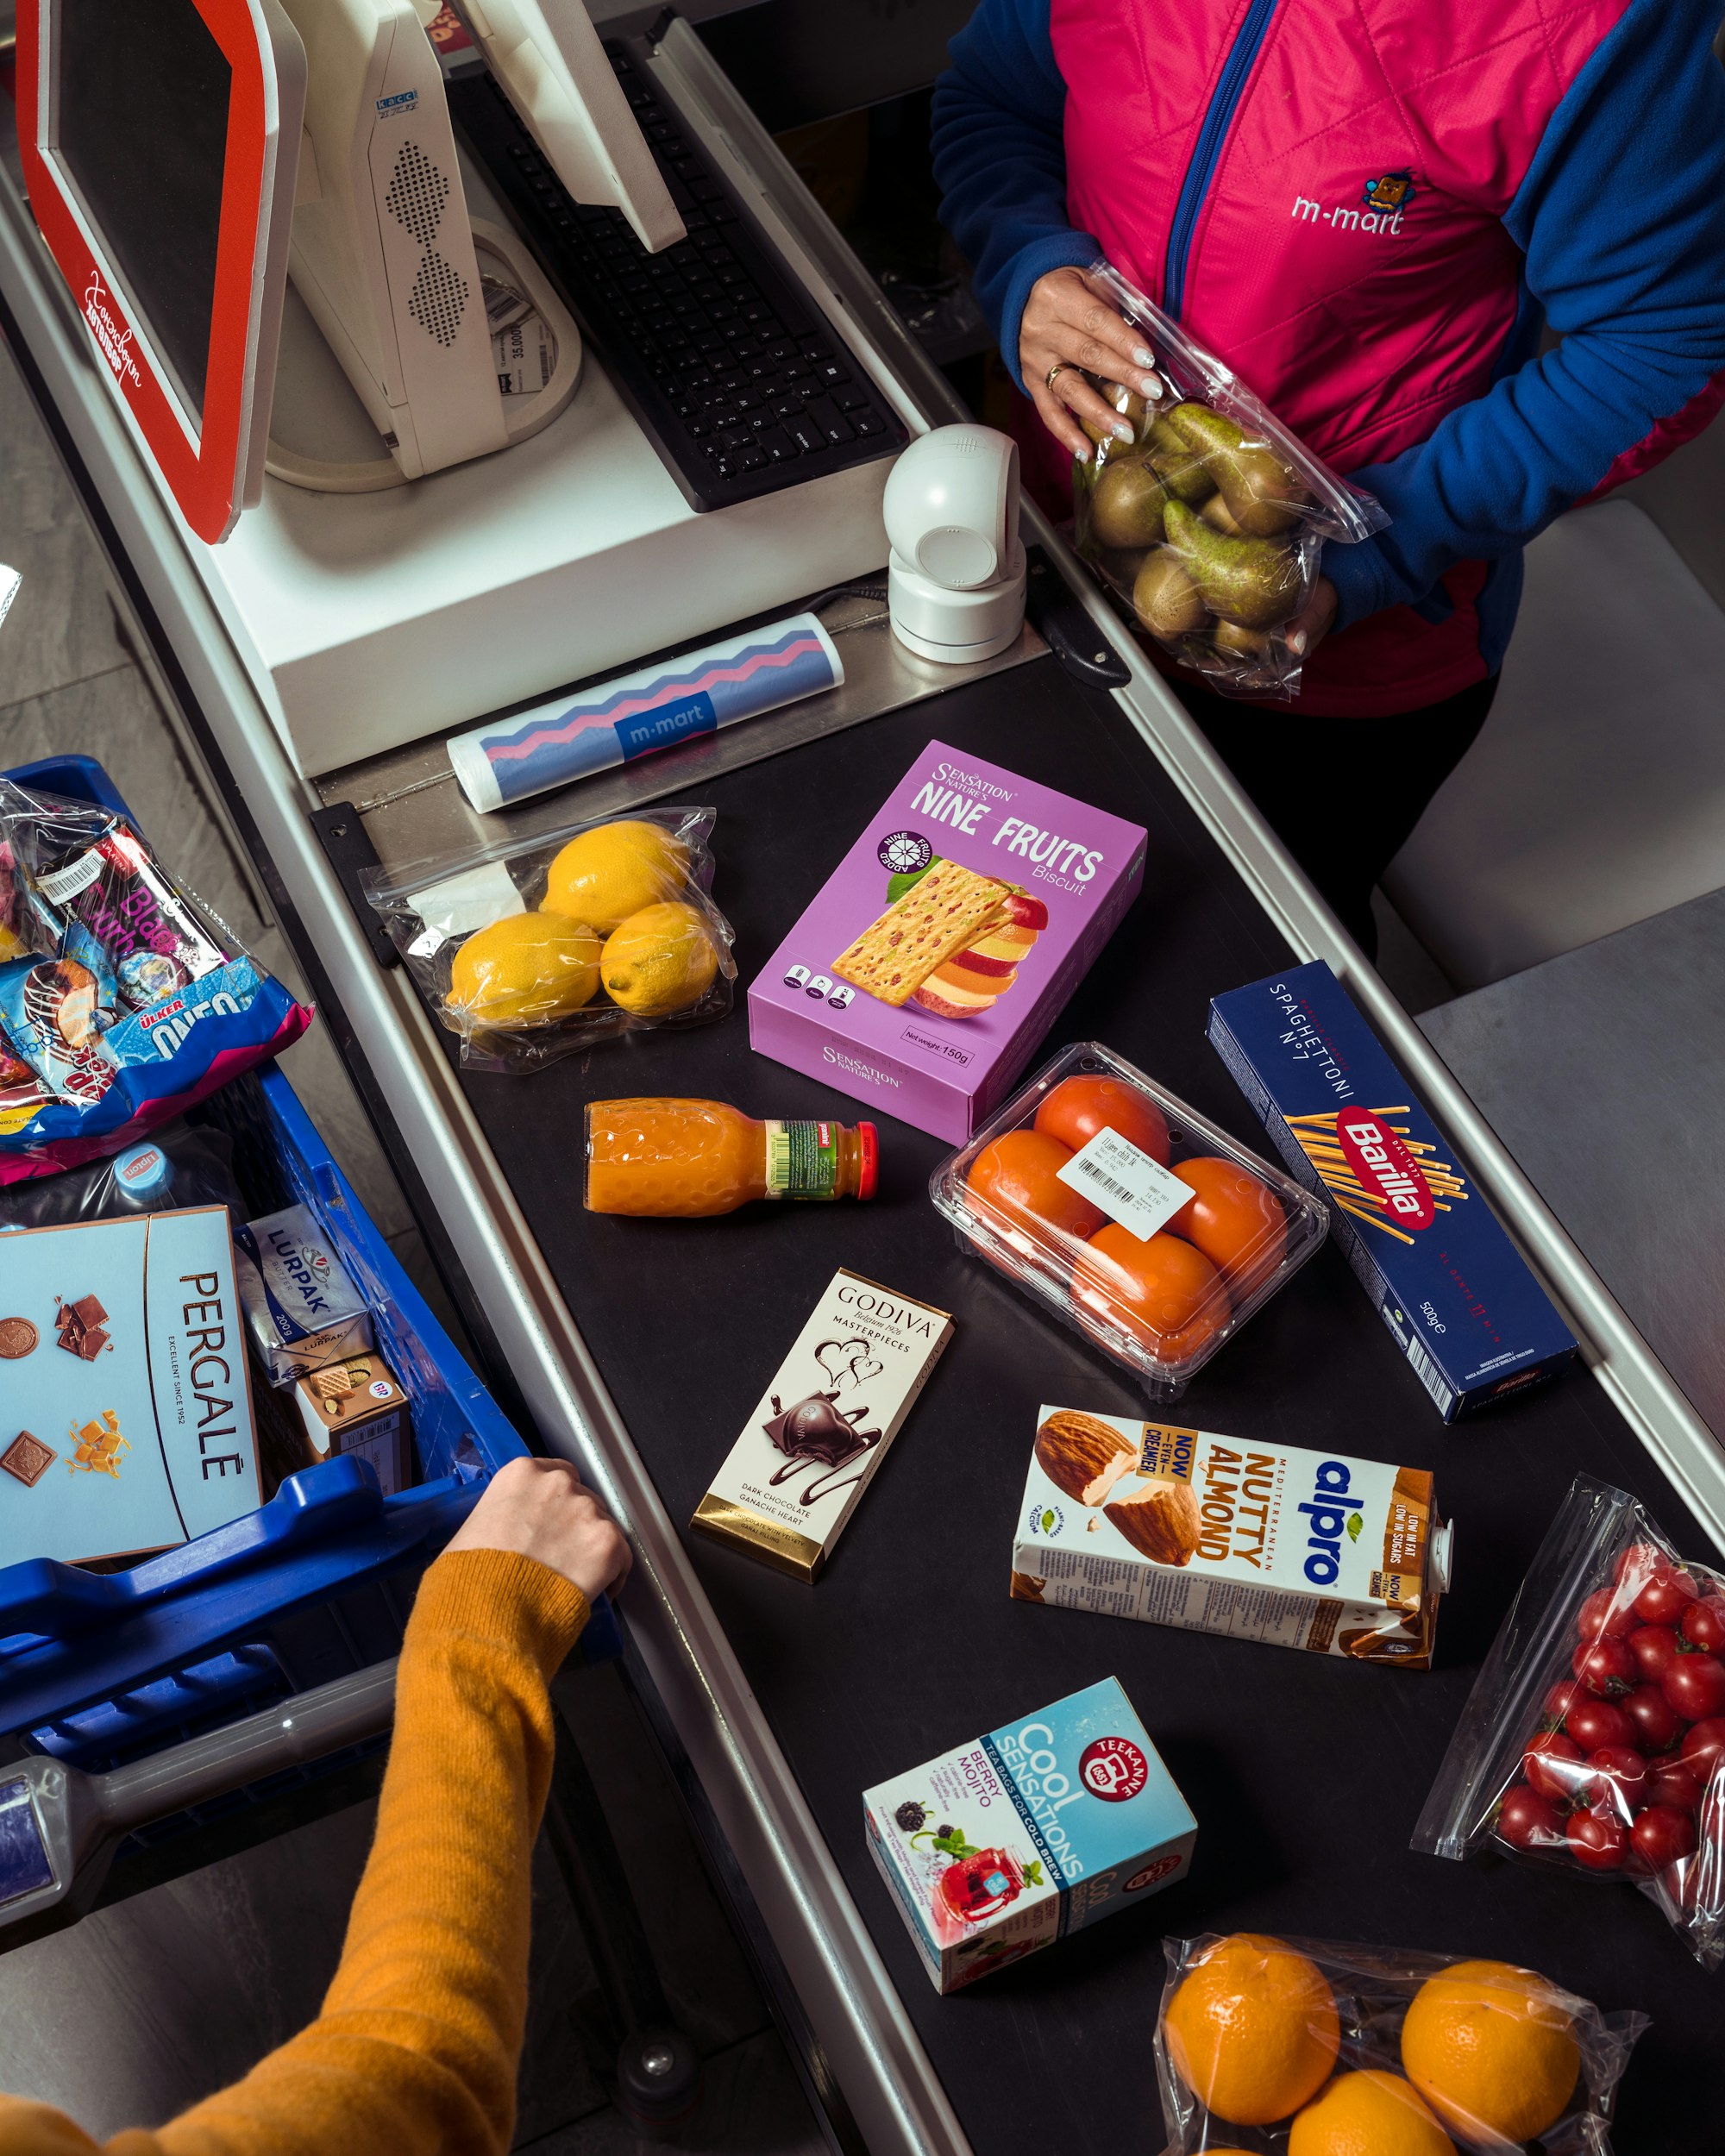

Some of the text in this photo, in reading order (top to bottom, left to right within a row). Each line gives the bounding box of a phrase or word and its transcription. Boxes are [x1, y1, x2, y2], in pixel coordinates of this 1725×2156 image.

[1292, 196, 1404, 235] m-mart
[762, 329, 770, 338] V
[738, 398, 748, 407] W
[779, 405, 787, 414] A
[932, 762, 1013, 803] SENSATION
[880, 832, 930, 872] NINE FRUITS ADDED
[911, 781, 990, 836] NINE
[993, 818, 1104, 882] FRUITS
[1032, 865, 1087, 896] Biscuit
[139, 1000, 185, 1030] ÜLKER
[906, 1030, 920, 1044] Net
[943, 1044, 969, 1064] 150g
[1270, 983, 1354, 1100] SPAGHETTONI
[823, 1046, 900, 1088] SENSATION
[124, 1152, 156, 1175] Lipton
[1344, 1121, 1420, 1216] Barilla
[1392, 1139, 1421, 1180] DAL 1877
[267, 1229, 329, 1314] LURPAK
[272, 1261, 293, 1292] BUTTER
[837, 1286, 931, 1338] GODIVA
[853, 1309, 902, 1336] Belgium 1926
[304, 1332, 344, 1351] LURPAK
[831, 1314, 911, 1353] MASTERPIECES
[169, 1336, 185, 1425] EXCELLENT SINCE 1952
[1139, 1428, 1162, 1473] CREAMIER
[1163, 1443, 1173, 1465] EVEN
[1172, 1433, 1193, 1479] NOW
[738, 1493, 804, 1526] GANACHE HEART
[741, 1482, 812, 1519] DARK CHOCOLATE
[1195, 1444, 1243, 1562] ALMOND
[1233, 1451, 1276, 1570] NUTTY
[1265, 1457, 1287, 1571] MEDITERRANEAN
[1296, 1460, 1364, 1585] alpro
[1389, 1503, 1407, 1564] LOW IN SUGARS
[1404, 1514, 1419, 1557] LOW IN FAT
[1389, 1575, 1401, 1600] NOW
[949, 1765, 970, 1799] calorie-free
[957, 1757, 991, 1808] MOJITO
[969, 1750, 1003, 1797] BERRY
[1019, 1723, 1085, 1811] Cool
[1092, 1765, 1109, 1786] 1882
[1096, 1739, 1145, 1797] TEEKANNE
[986, 1744, 1063, 1881] TEA BAGS FOR COLD BREW
[996, 1735, 1083, 1879] SENSATIONS
